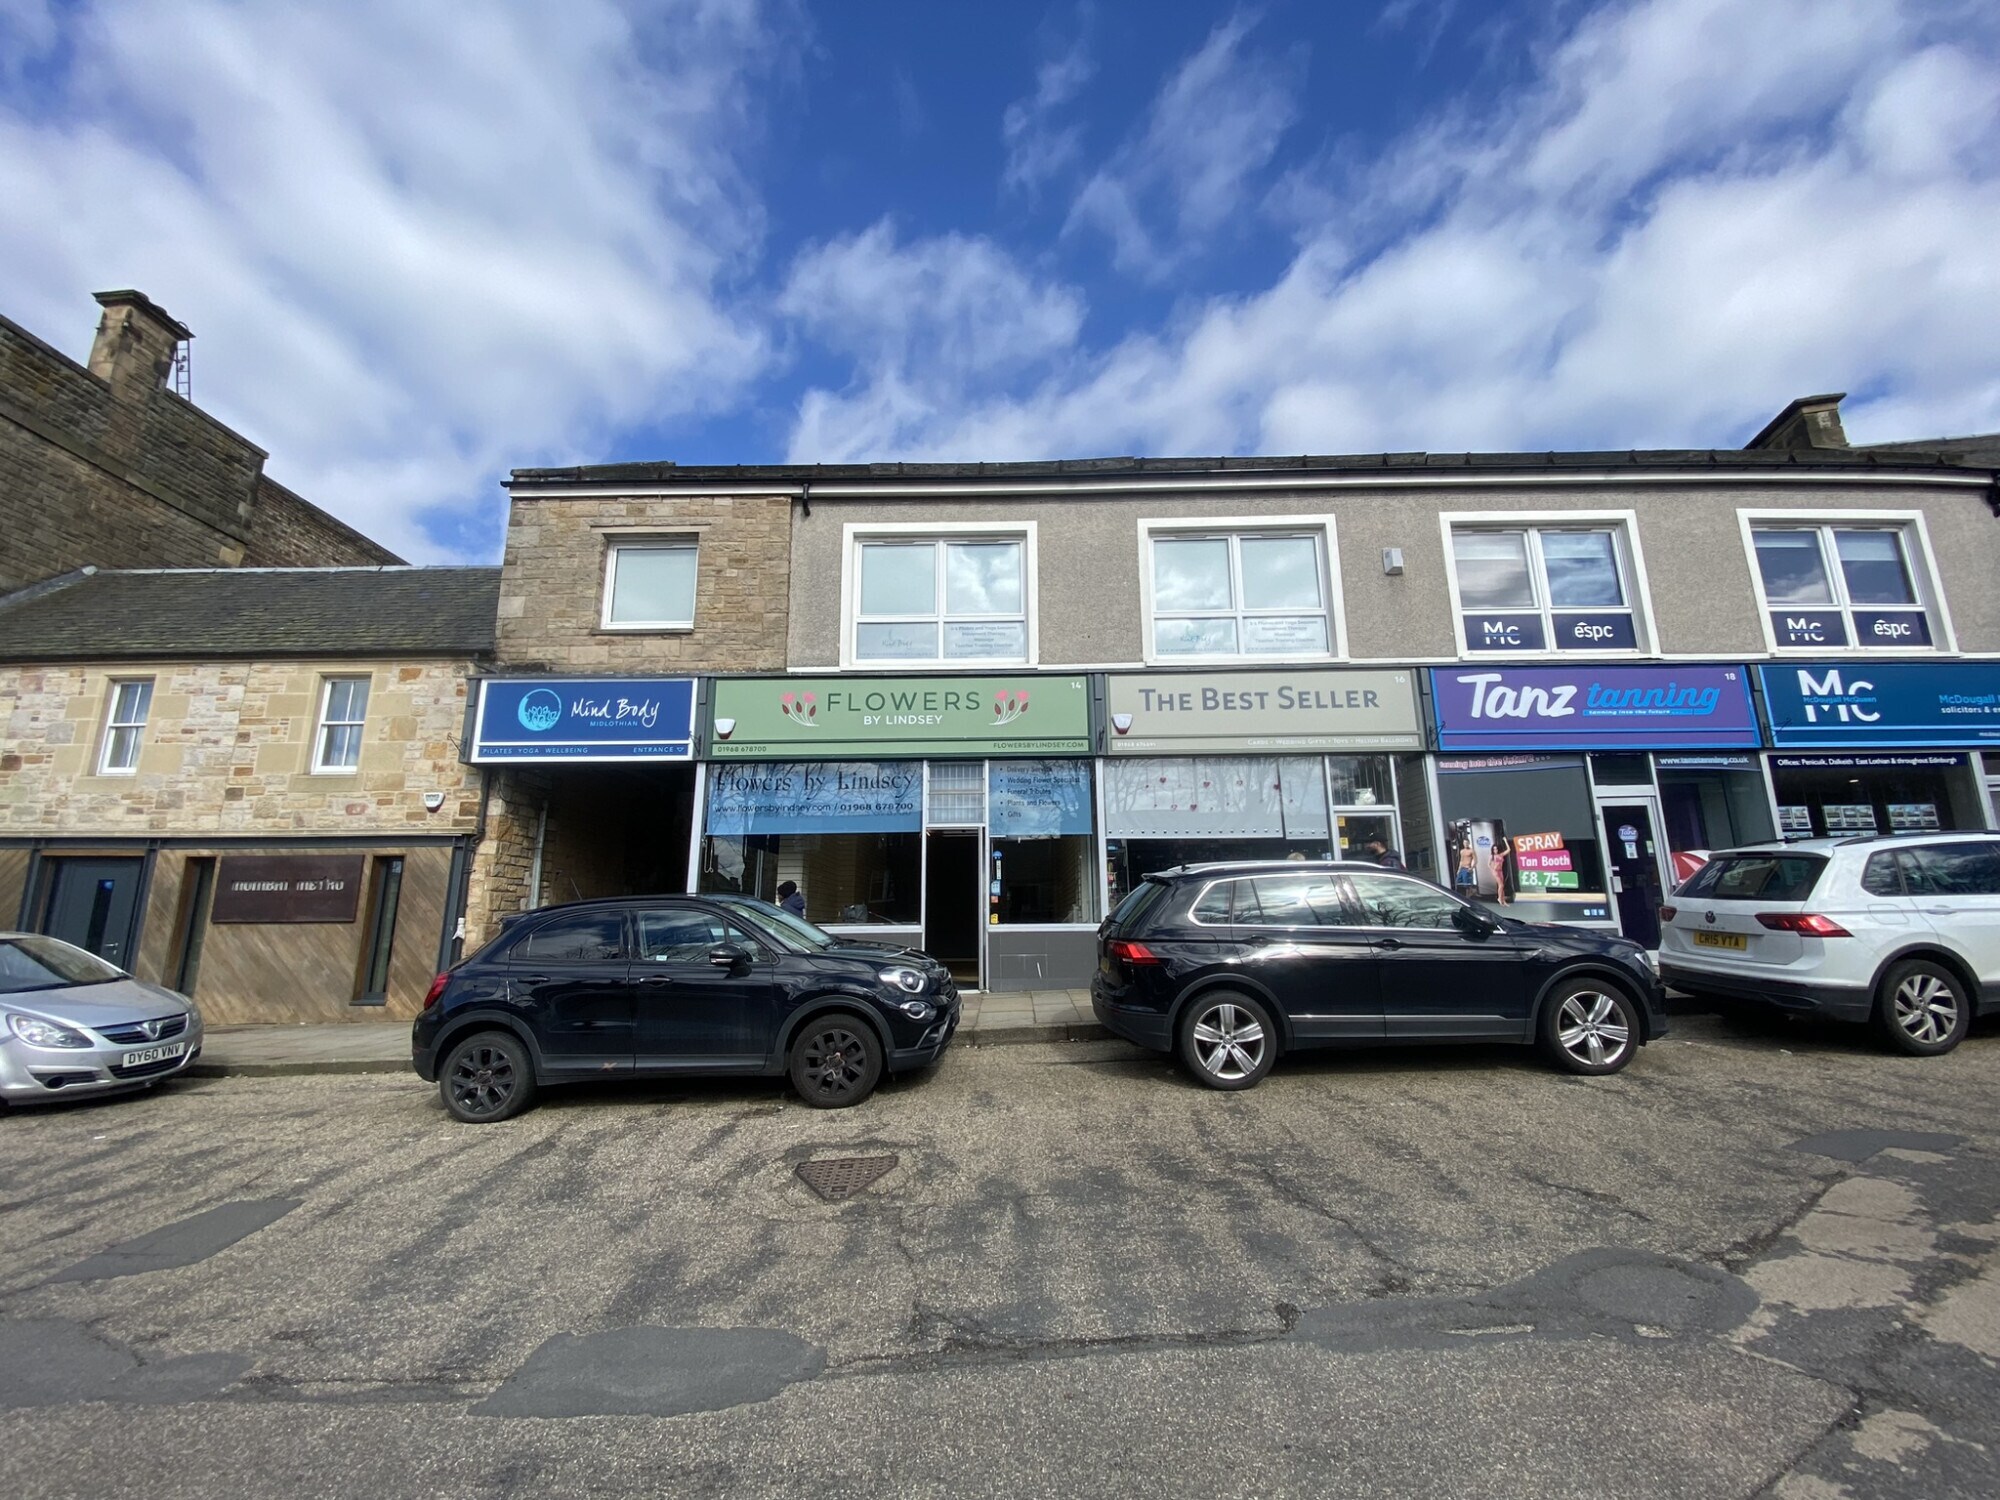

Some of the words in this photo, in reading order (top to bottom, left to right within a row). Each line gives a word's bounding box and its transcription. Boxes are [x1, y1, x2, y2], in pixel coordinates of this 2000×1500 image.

[1394, 676, 1406, 684] 16
[1724, 672, 1736, 680] 18
[1070, 682, 1082, 690] 14
[826, 691, 980, 712] FLOWERS
[1456, 673, 1578, 719] Tanz
[1586, 682, 1721, 716] tanning
[1938, 694, 1996, 705] McDougall
[571, 698, 611, 720] Mind
[616, 698, 660, 728] Body
[864, 716, 882, 726] BY
[886, 714, 944, 725] LINDSEY
[716, 771, 792, 792] Flowers
[804, 770, 826, 800] by
[838, 771, 915, 799] Lindsey
[1517, 833, 1560, 852] SPRAY
[1520, 857, 1538, 867] Tan
[1542, 854, 1570, 867] Booth
[1521, 871, 1560, 886] £8.75
[128, 1048, 159, 1064] DY60
[162, 1044, 181, 1058] VNV
